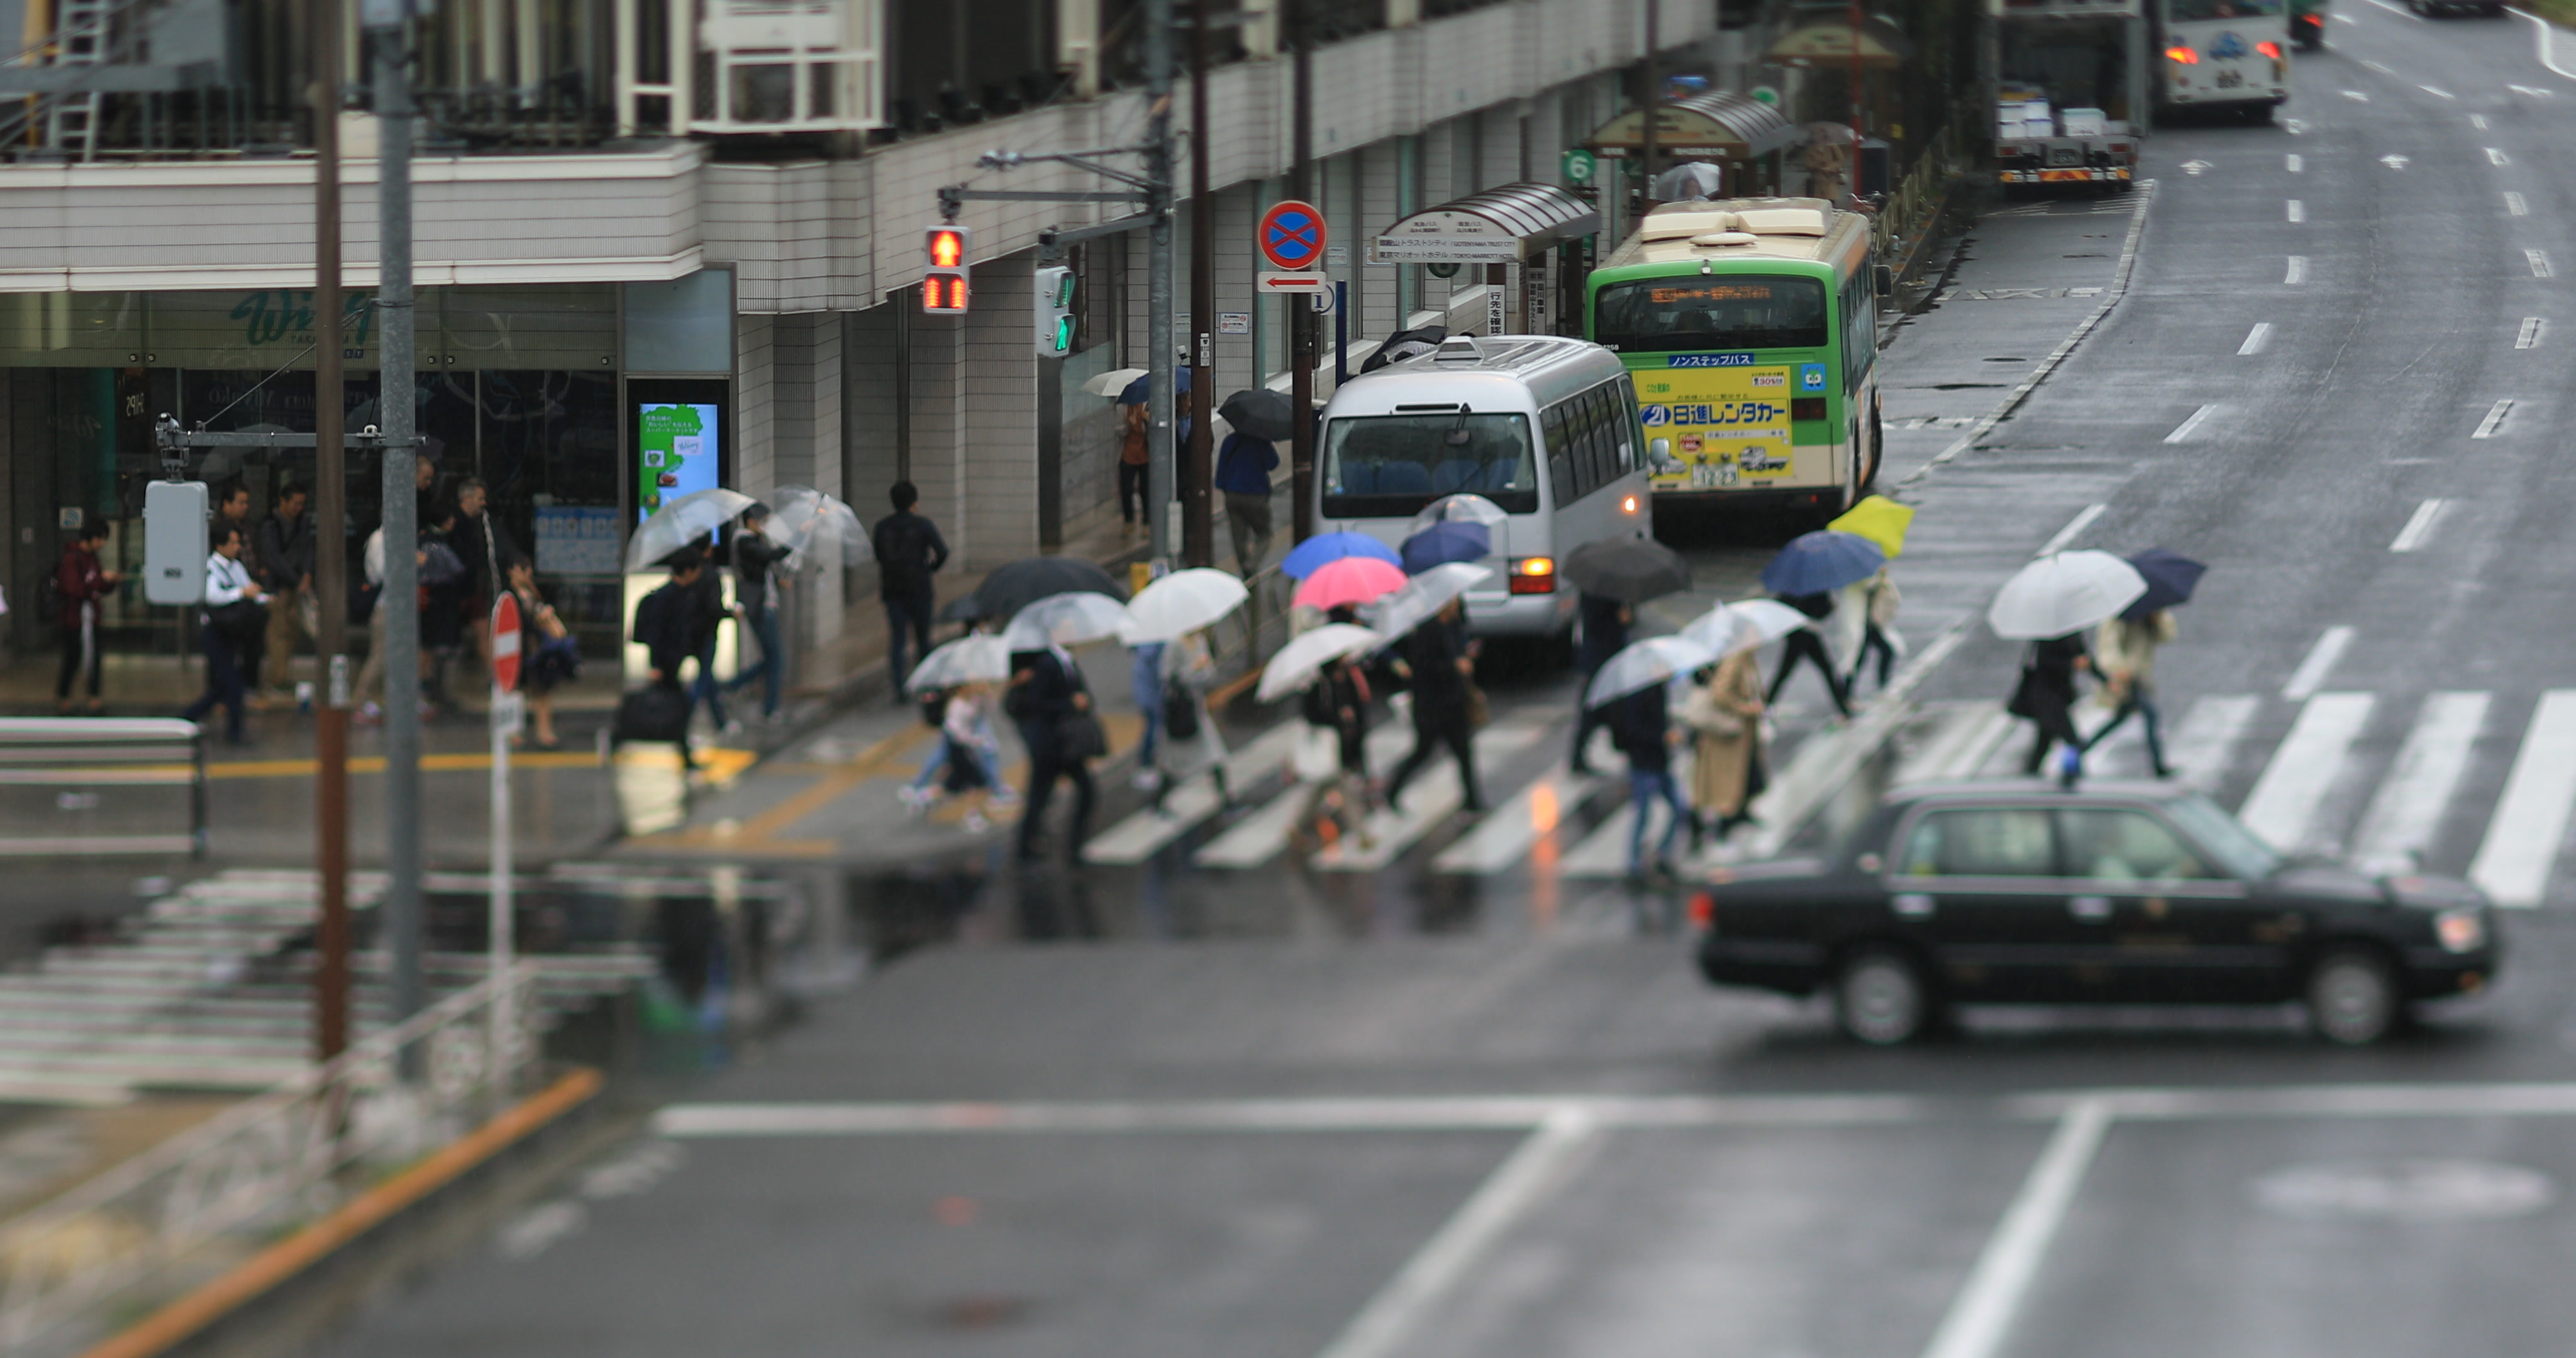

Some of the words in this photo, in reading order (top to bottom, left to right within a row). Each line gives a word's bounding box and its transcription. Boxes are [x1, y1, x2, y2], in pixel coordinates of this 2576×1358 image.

[1569, 156, 1589, 177] 6
[1379, 251, 1447, 259] 東京マリオットホテル
[230, 289, 376, 345] Wig
[1671, 355, 1750, 367] ノンステップバス
[1674, 402, 1785, 425] 日進レンタカー
